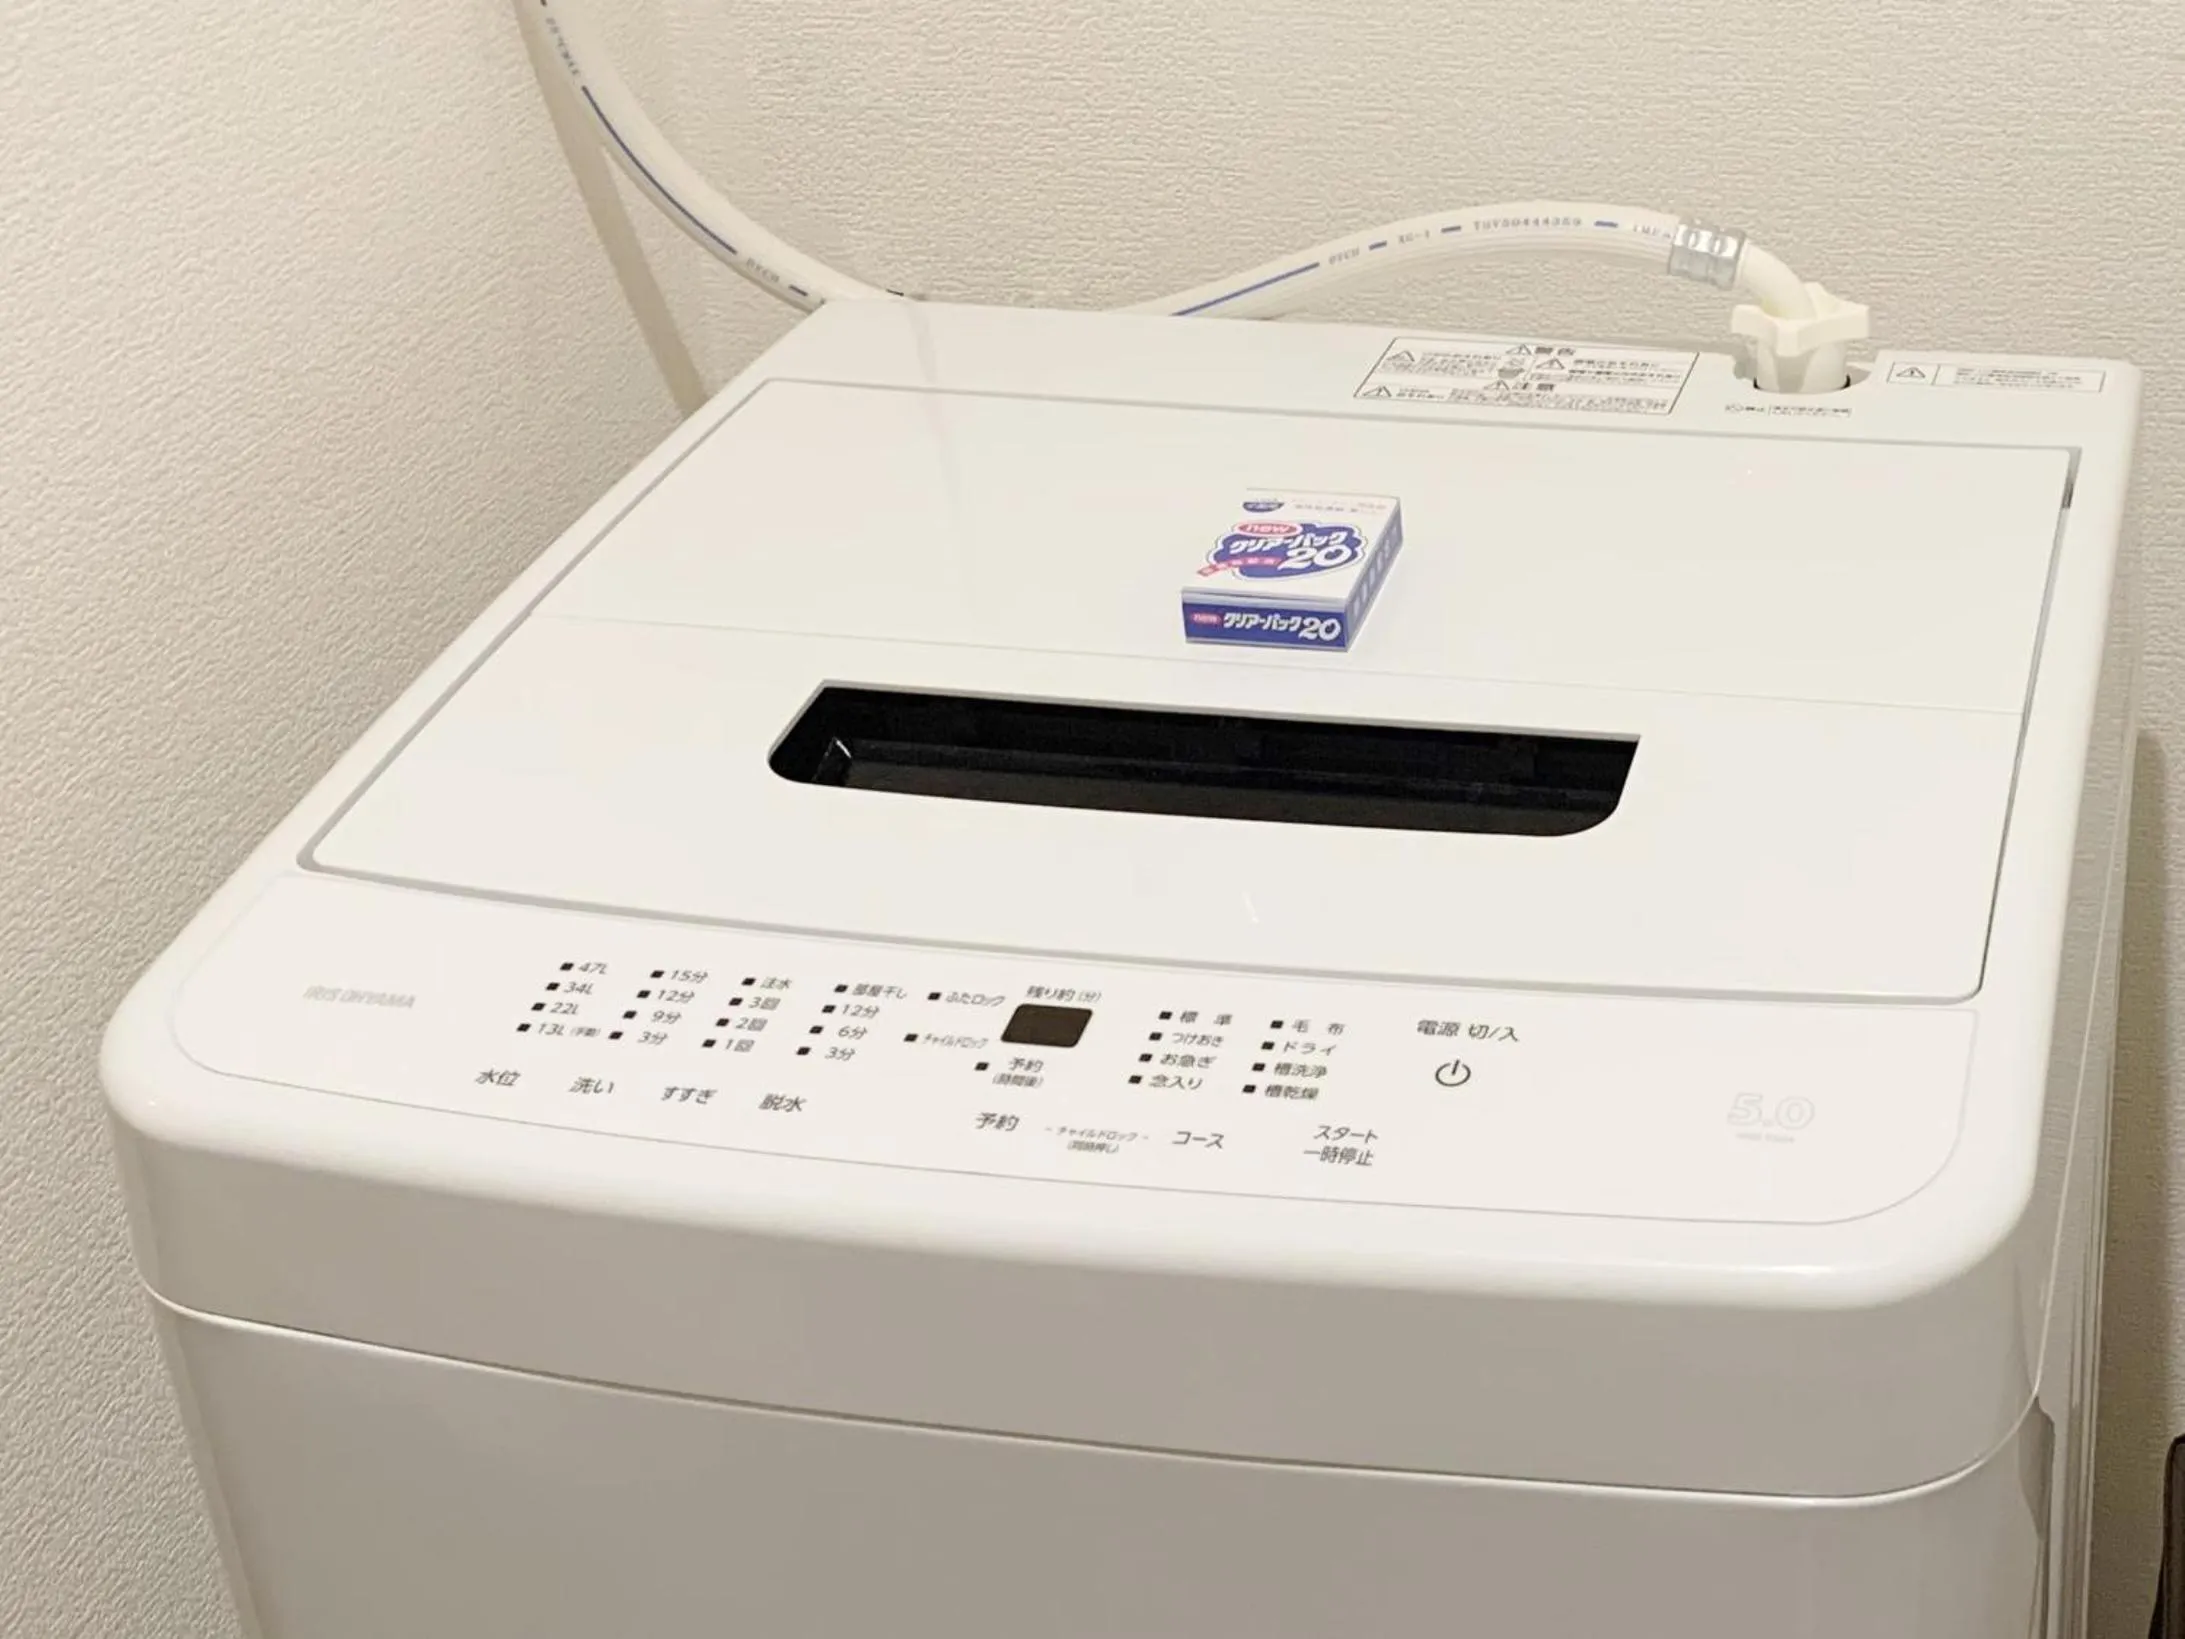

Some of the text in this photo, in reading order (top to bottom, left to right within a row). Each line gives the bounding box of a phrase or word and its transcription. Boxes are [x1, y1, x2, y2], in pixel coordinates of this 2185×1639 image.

[1245, 522, 1292, 534] new
[1229, 530, 1348, 555] クリアーパック
[1277, 543, 1353, 571] 20
[578, 962, 608, 975] 47L
[670, 969, 708, 984] 15分
[563, 979, 594, 995] 34L
[657, 989, 695, 1004] 12分
[748, 996, 781, 1011] 3回
[945, 991, 1006, 1007] ふたロック
[549, 1001, 579, 1015] 22L
[842, 1004, 880, 1019] 12分
[651, 1010, 682, 1024] 9分
[734, 1017, 768, 1032] 2回
[637, 1031, 669, 1046] 3分
[836, 1025, 868, 1040] 6分
[1417, 1019, 1520, 1043] 電源 切/入
[725, 1038, 756, 1053] 1回
[1172, 1032, 1224, 1048] つけおき
[824, 1046, 856, 1062] 3分
[1283, 1041, 1336, 1056] ドライ
[1008, 1057, 1044, 1073] 予約
[1160, 1053, 1217, 1069] お急ぎ
[474, 1068, 522, 1087] 水位
[1273, 1062, 1328, 1080] 槽洗浄
[568, 1076, 615, 1096] 洗い
[1148, 1072, 1203, 1090] 念入り
[660, 1086, 718, 1105] すすぎ
[1264, 1084, 1320, 1101] 槽乾燥
[758, 1093, 807, 1113] 脱水
[1726, 1092, 1816, 1130] 5.0
[975, 1112, 1020, 1132] 予約
[1172, 1131, 1224, 1149] コース
[1313, 1124, 1379, 1144] スタート
[1303, 1145, 1374, 1167] 一時停止
